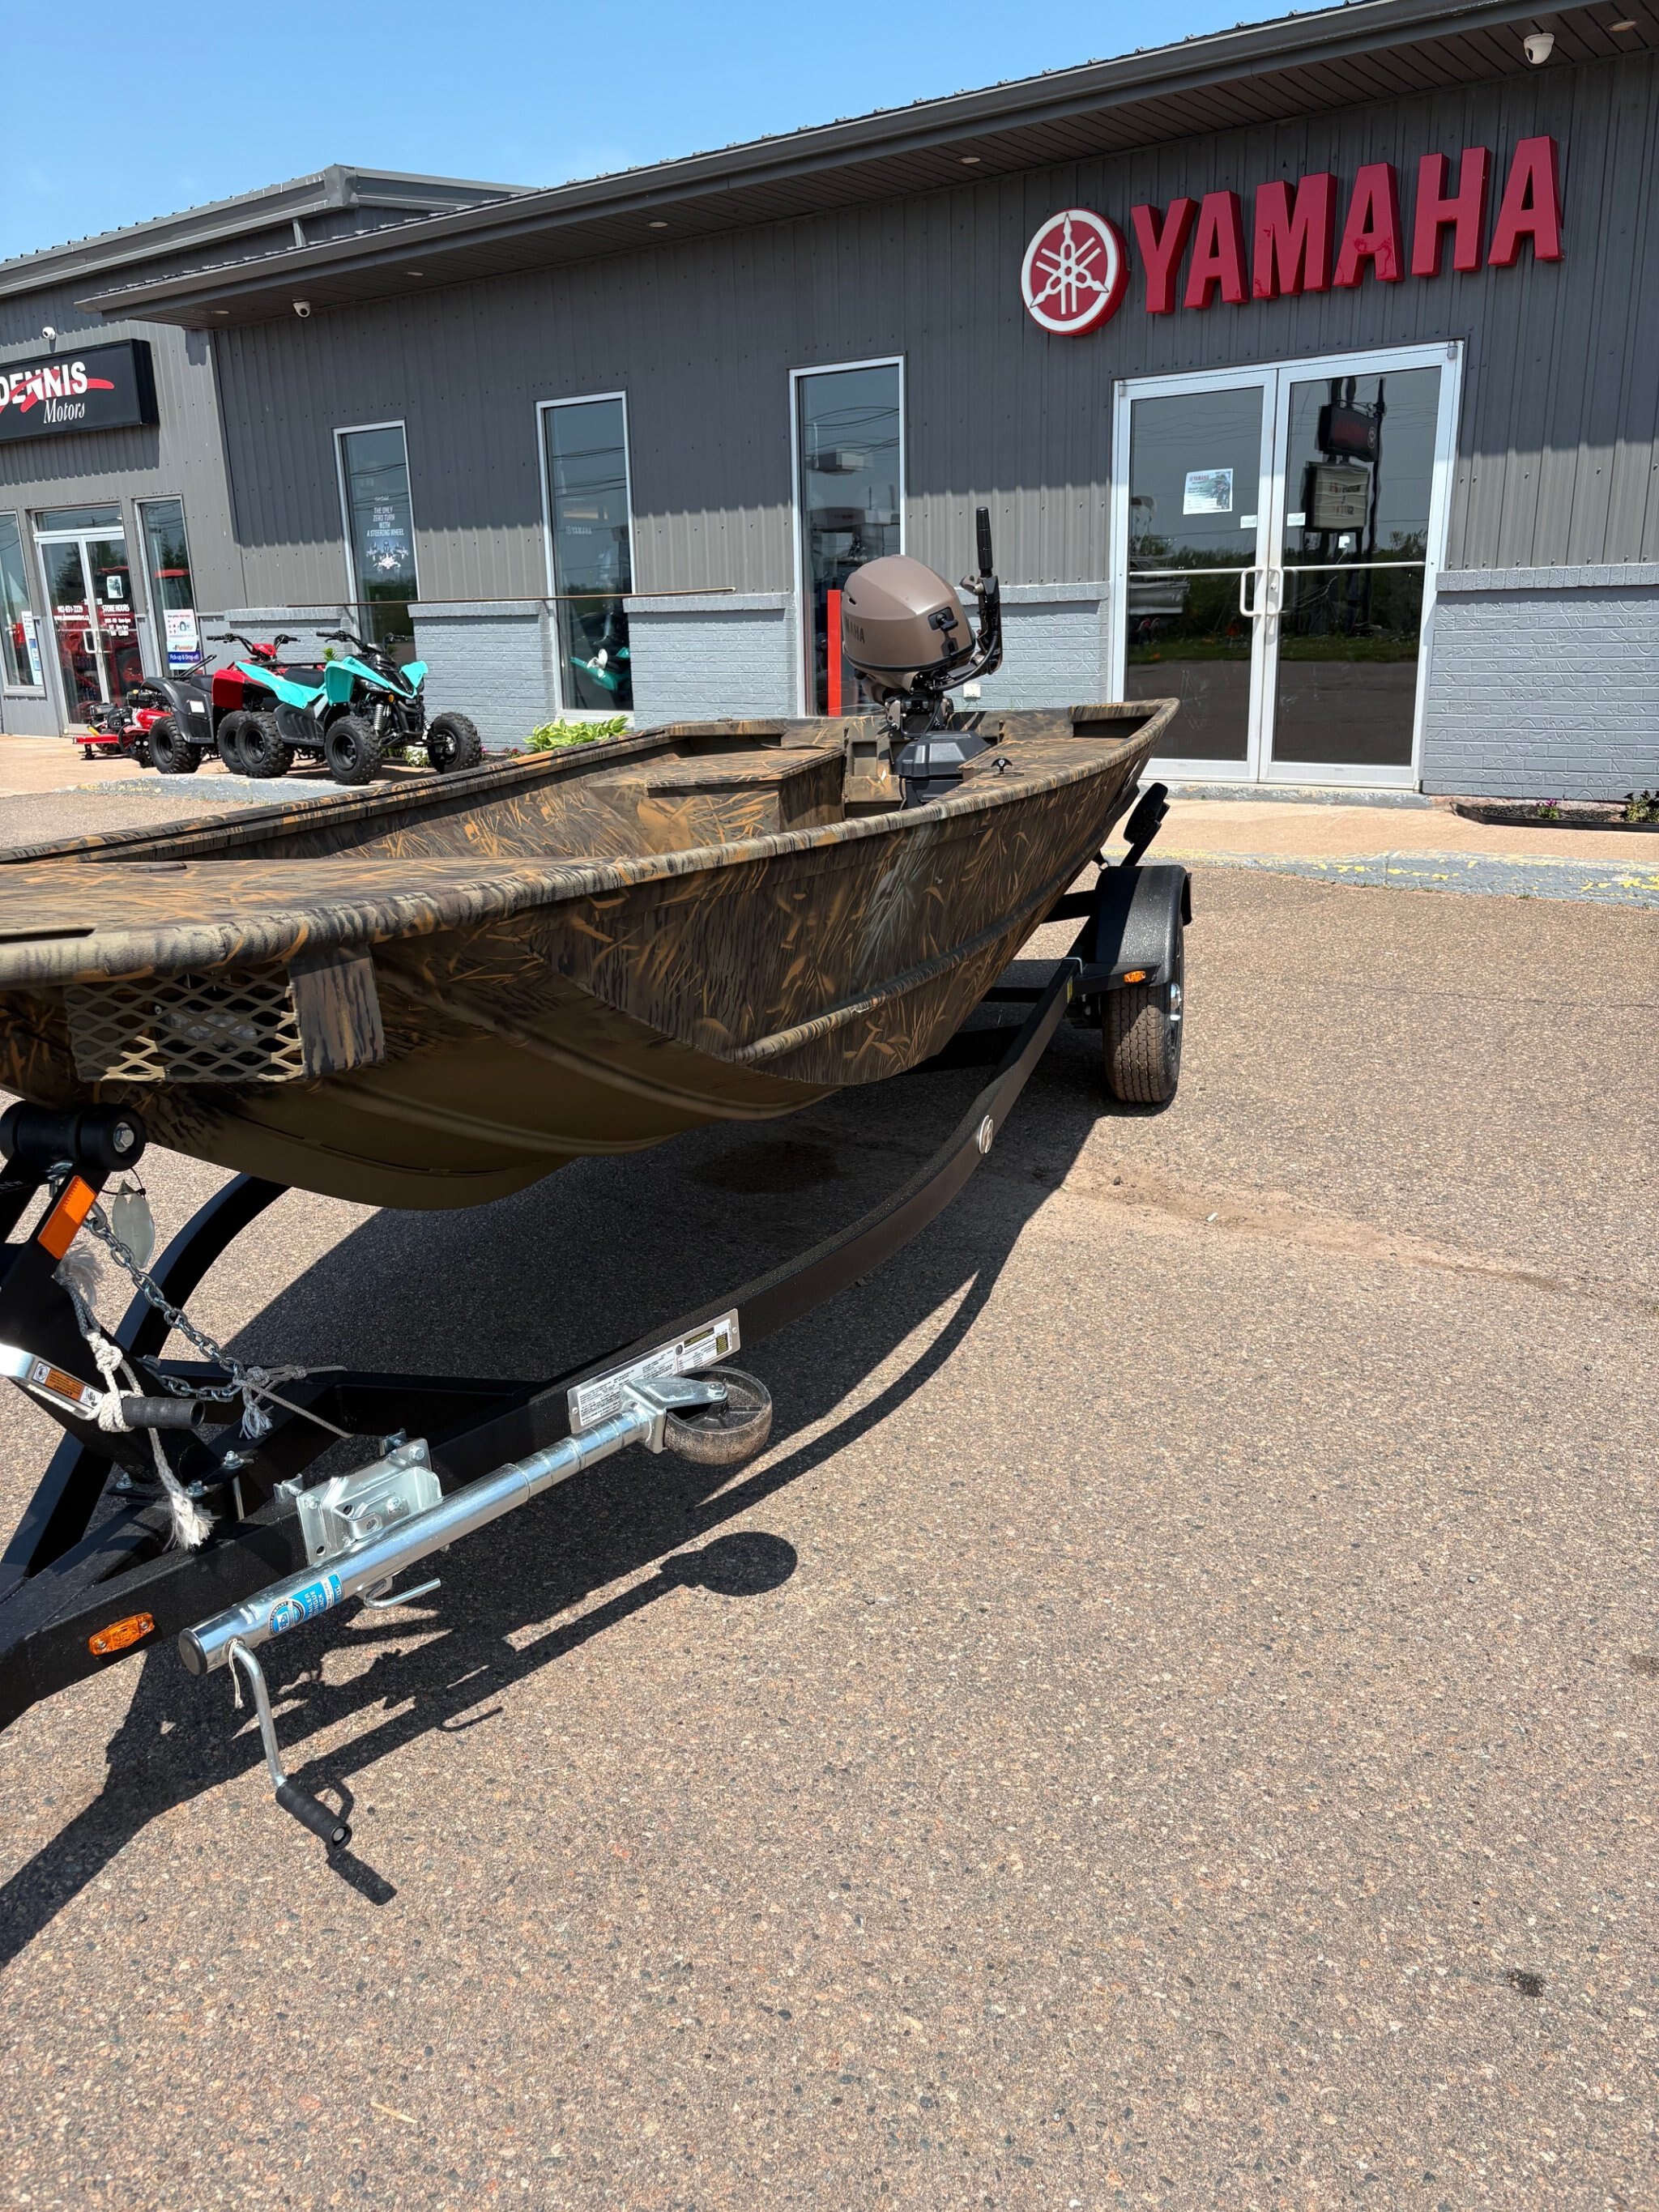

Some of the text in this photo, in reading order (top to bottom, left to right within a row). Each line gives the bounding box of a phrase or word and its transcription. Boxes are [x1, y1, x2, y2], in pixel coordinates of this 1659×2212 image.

[1131, 135, 1563, 314] YAMAHA
[0, 361, 87, 406] DENNIS
[43, 399, 86, 424] Motors
[309, 1589, 319, 1614] ONGUE
